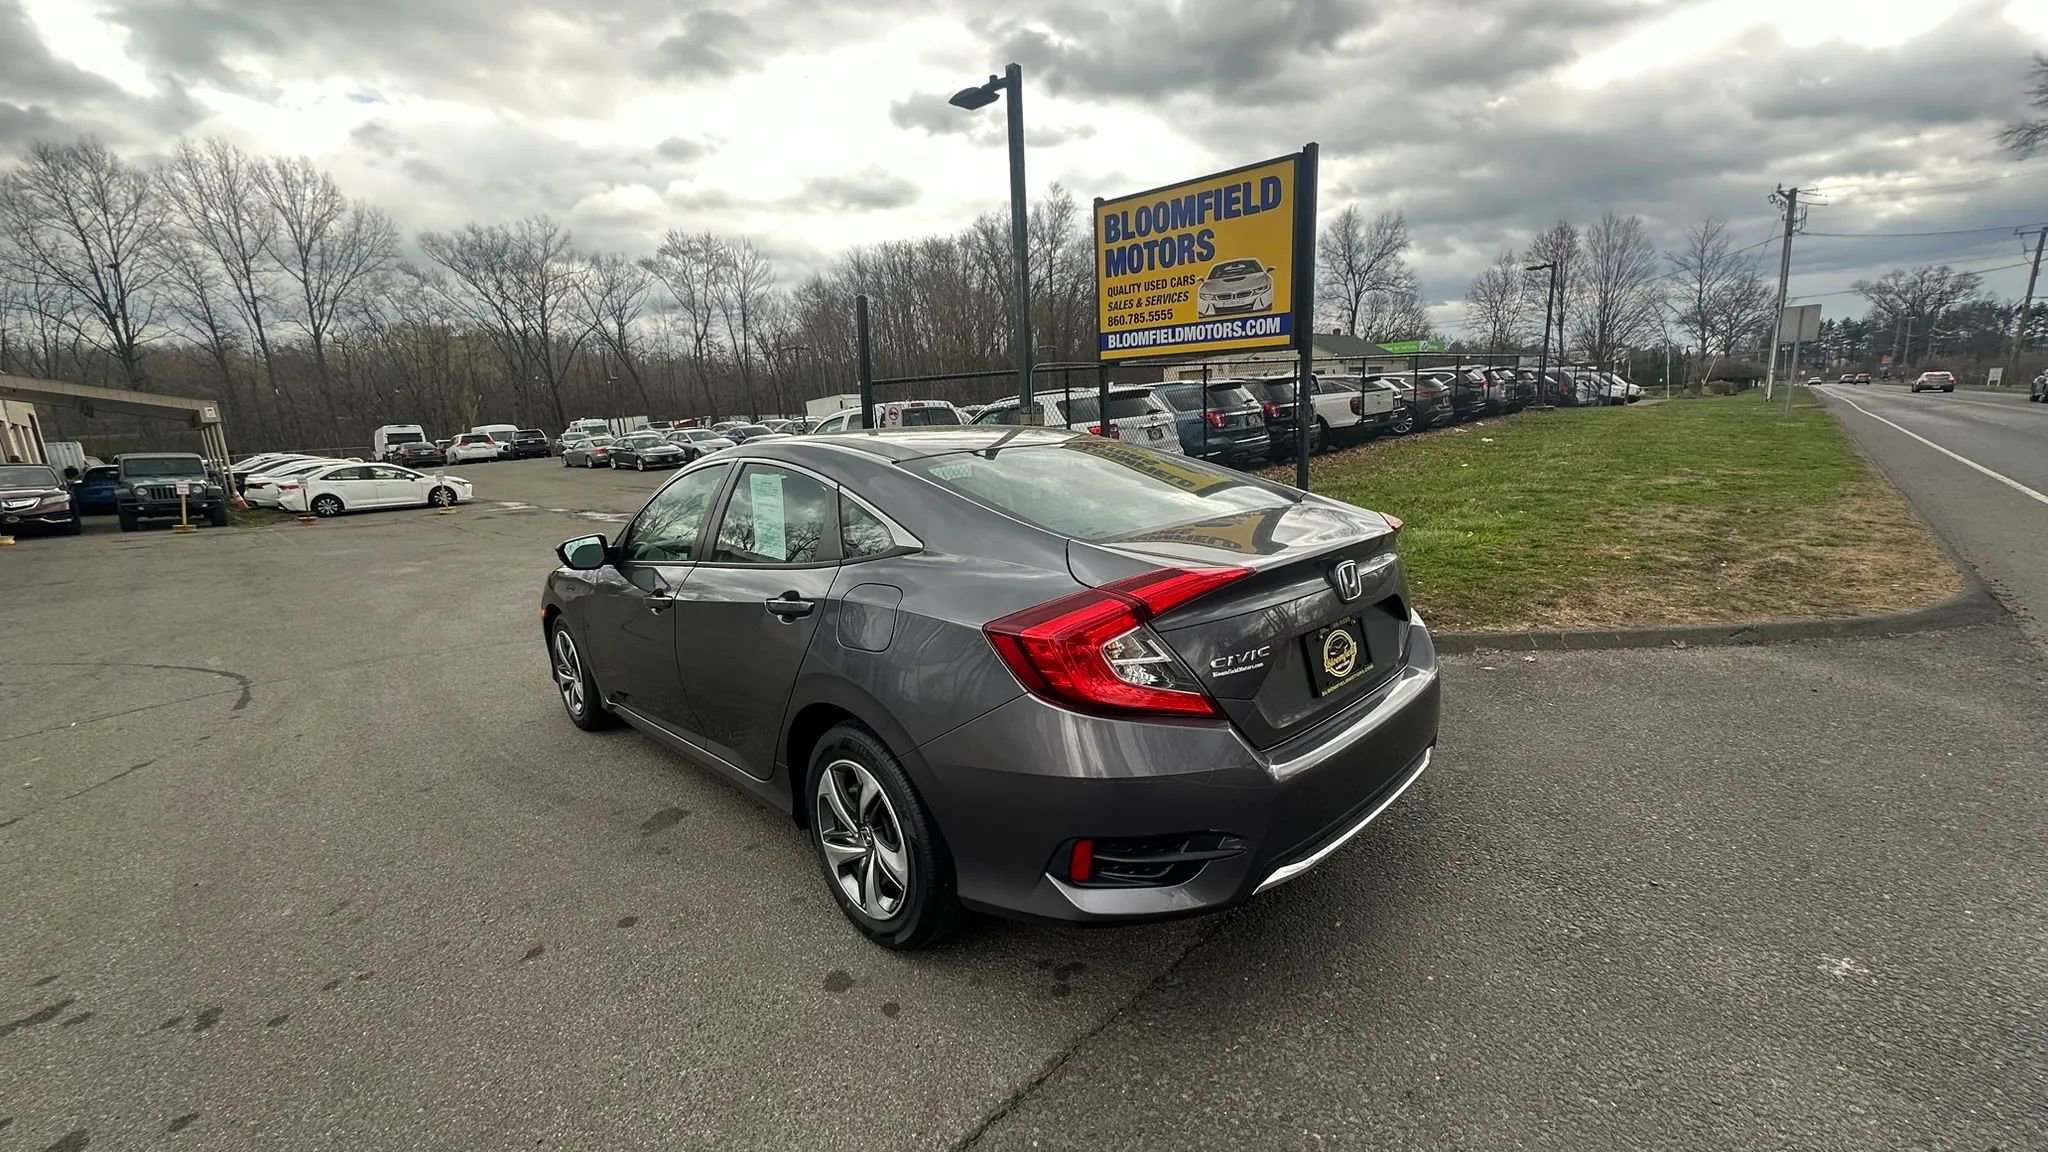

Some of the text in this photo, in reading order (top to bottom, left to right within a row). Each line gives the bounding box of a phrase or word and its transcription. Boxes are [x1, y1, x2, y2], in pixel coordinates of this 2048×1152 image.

[1104, 175, 1282, 244] BLOOMFIELD
[1105, 228, 1216, 278] MOTORS
[1107, 274, 1196, 297] QUALITY USED CARS
[1107, 291, 1189, 312] SALES & SERVICES
[1107, 308, 1174, 327] 860.785.5555
[1107, 316, 1281, 349] BLOOMFIELDMOTORS.COM
[1021, 406, 1043, 414] NOICE
[1210, 645, 1270, 668] CIVIC
